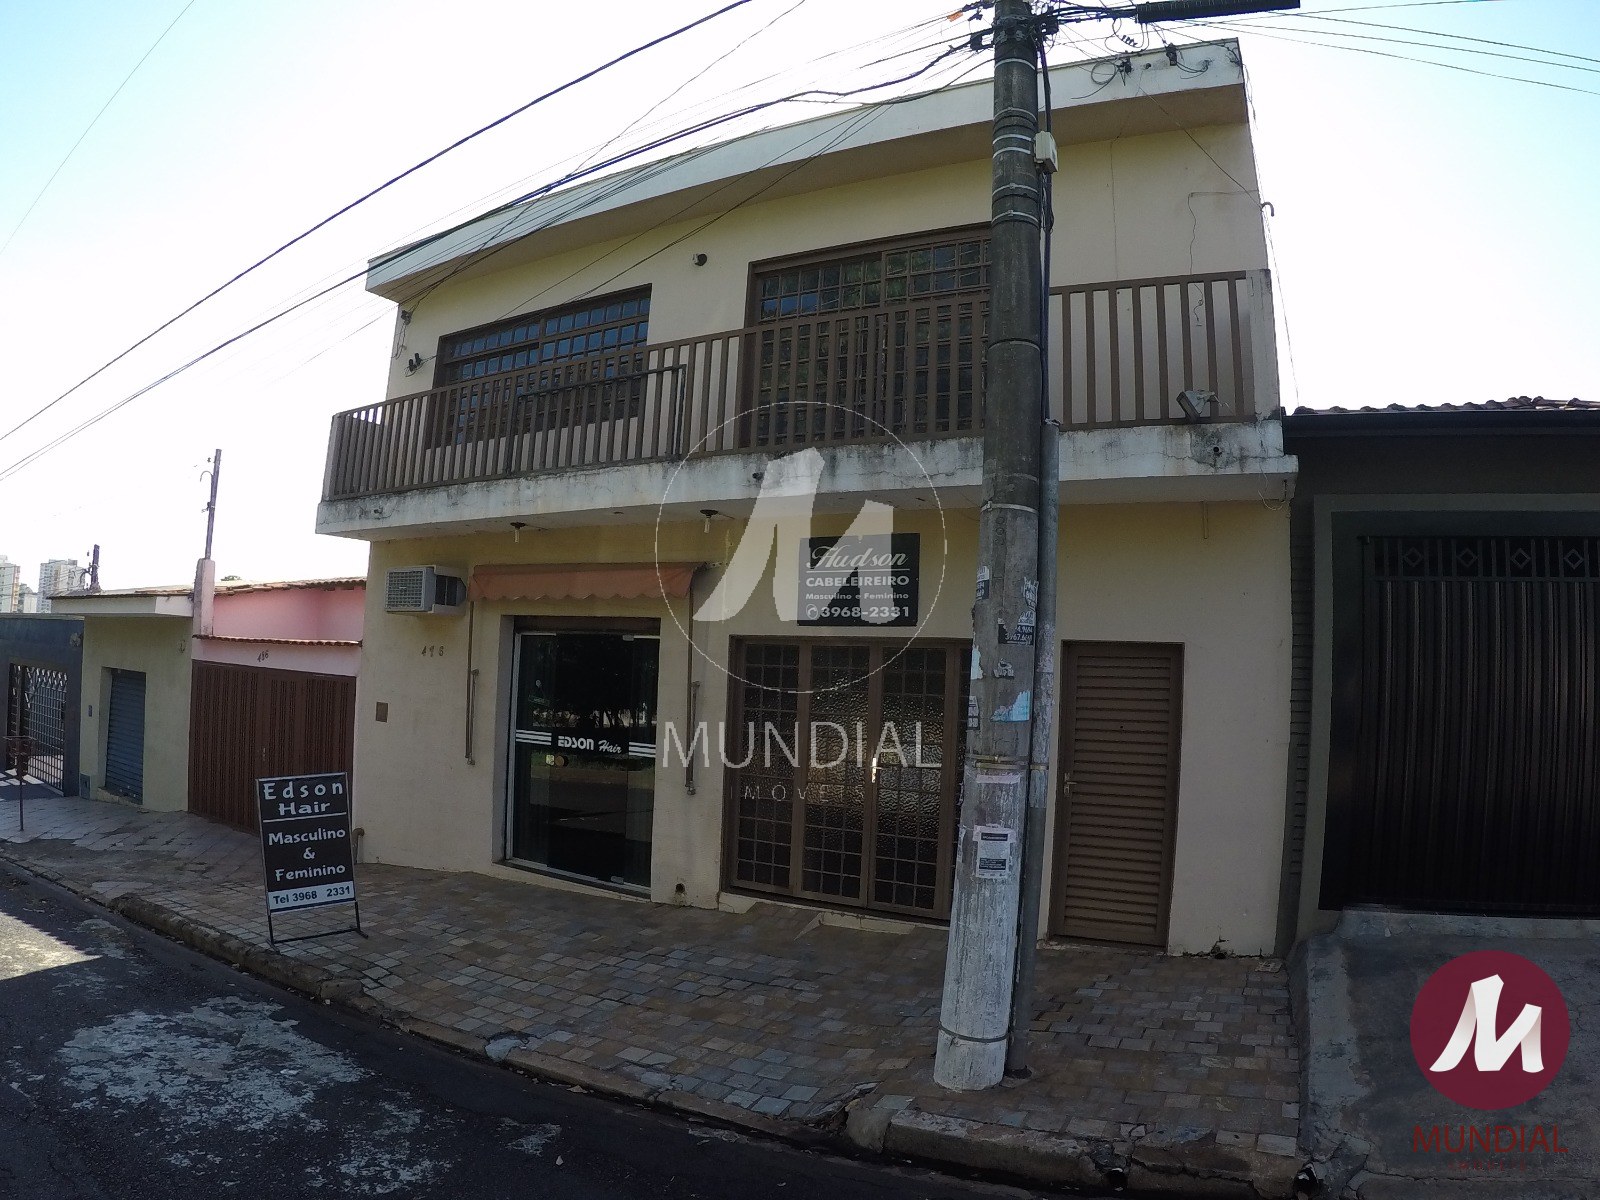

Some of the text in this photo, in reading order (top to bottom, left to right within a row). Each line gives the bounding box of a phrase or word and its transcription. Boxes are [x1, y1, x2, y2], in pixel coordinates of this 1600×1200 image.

[805, 544, 908, 569] Hudson
[805, 575, 910, 587] CABELEIREIRO
[805, 592, 852, 600] Masculino
[864, 592, 909, 600] Feminino
[820, 606, 909, 618] 3968-2331
[557, 735, 622, 754] EDSON Hair
[263, 781, 343, 800] Edson
[278, 801, 331, 816] Hair
[268, 828, 346, 845] Masculino
[303, 847, 316, 860] &
[275, 864, 346, 881] Feminino
[273, 886, 351, 905] Tel 3968 2331
